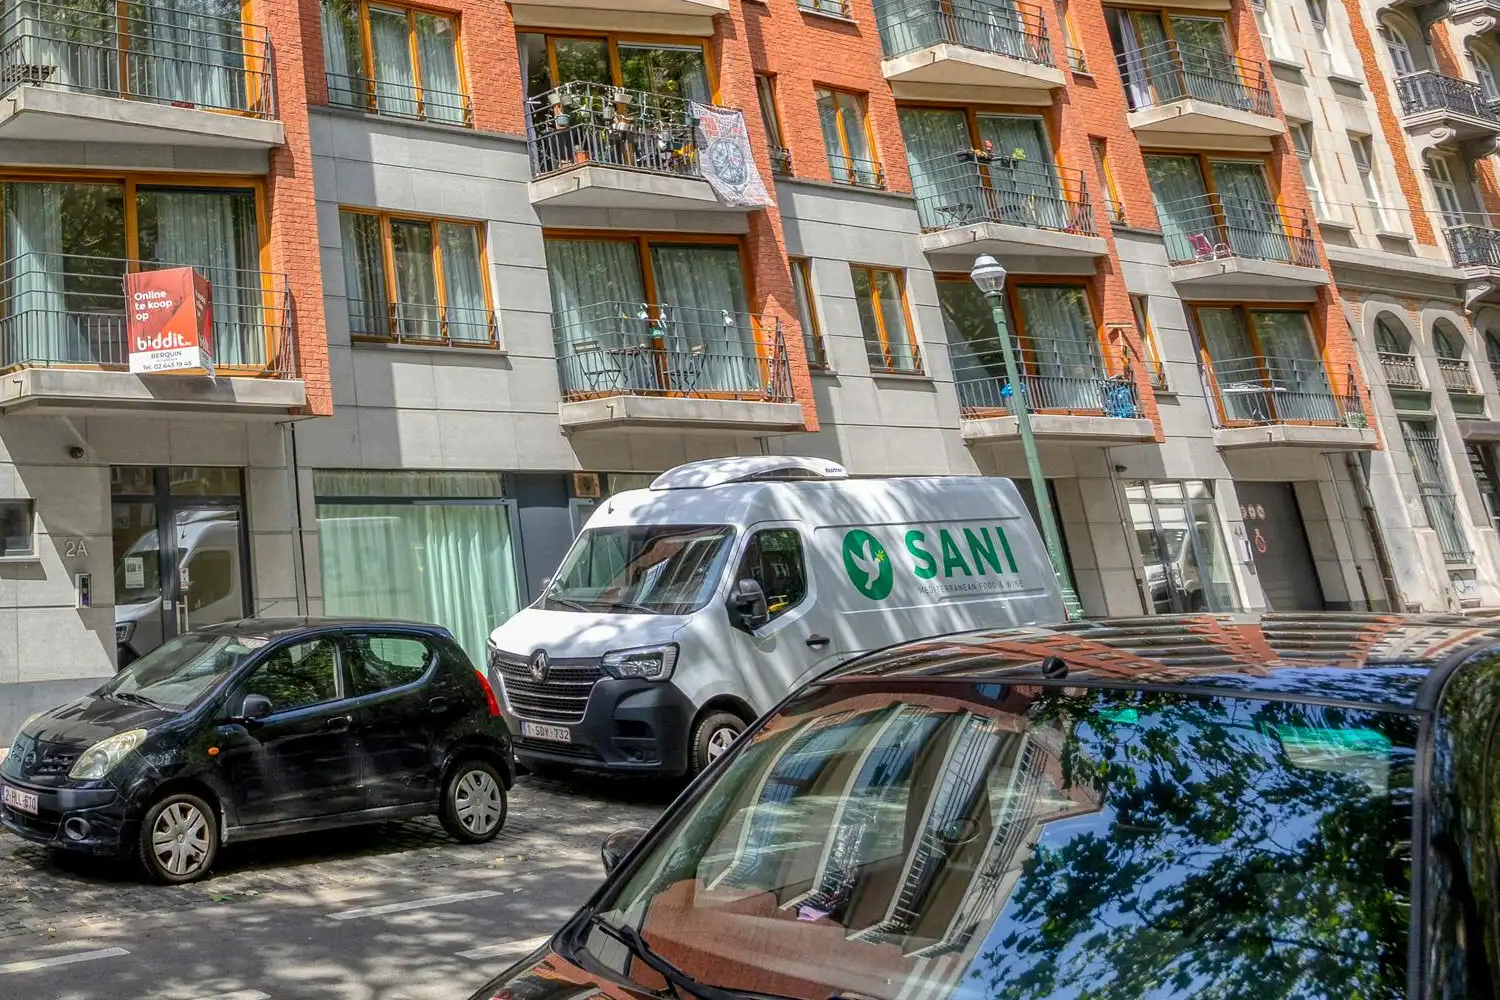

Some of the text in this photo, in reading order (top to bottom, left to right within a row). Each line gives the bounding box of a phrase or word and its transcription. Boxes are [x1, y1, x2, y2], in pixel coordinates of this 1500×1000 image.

[134, 290, 167, 301] Online
[147, 299, 173, 309] koop
[136, 313, 149, 321] op
[151, 351, 182, 359] BERQUIN
[65, 540, 89, 557] 2A
[905, 526, 1019, 580] SANI
[919, 583, 977, 594] MEDITERRANEAN
[979, 581, 997, 590] FOOD
[1007, 579, 1024, 589] WINE
